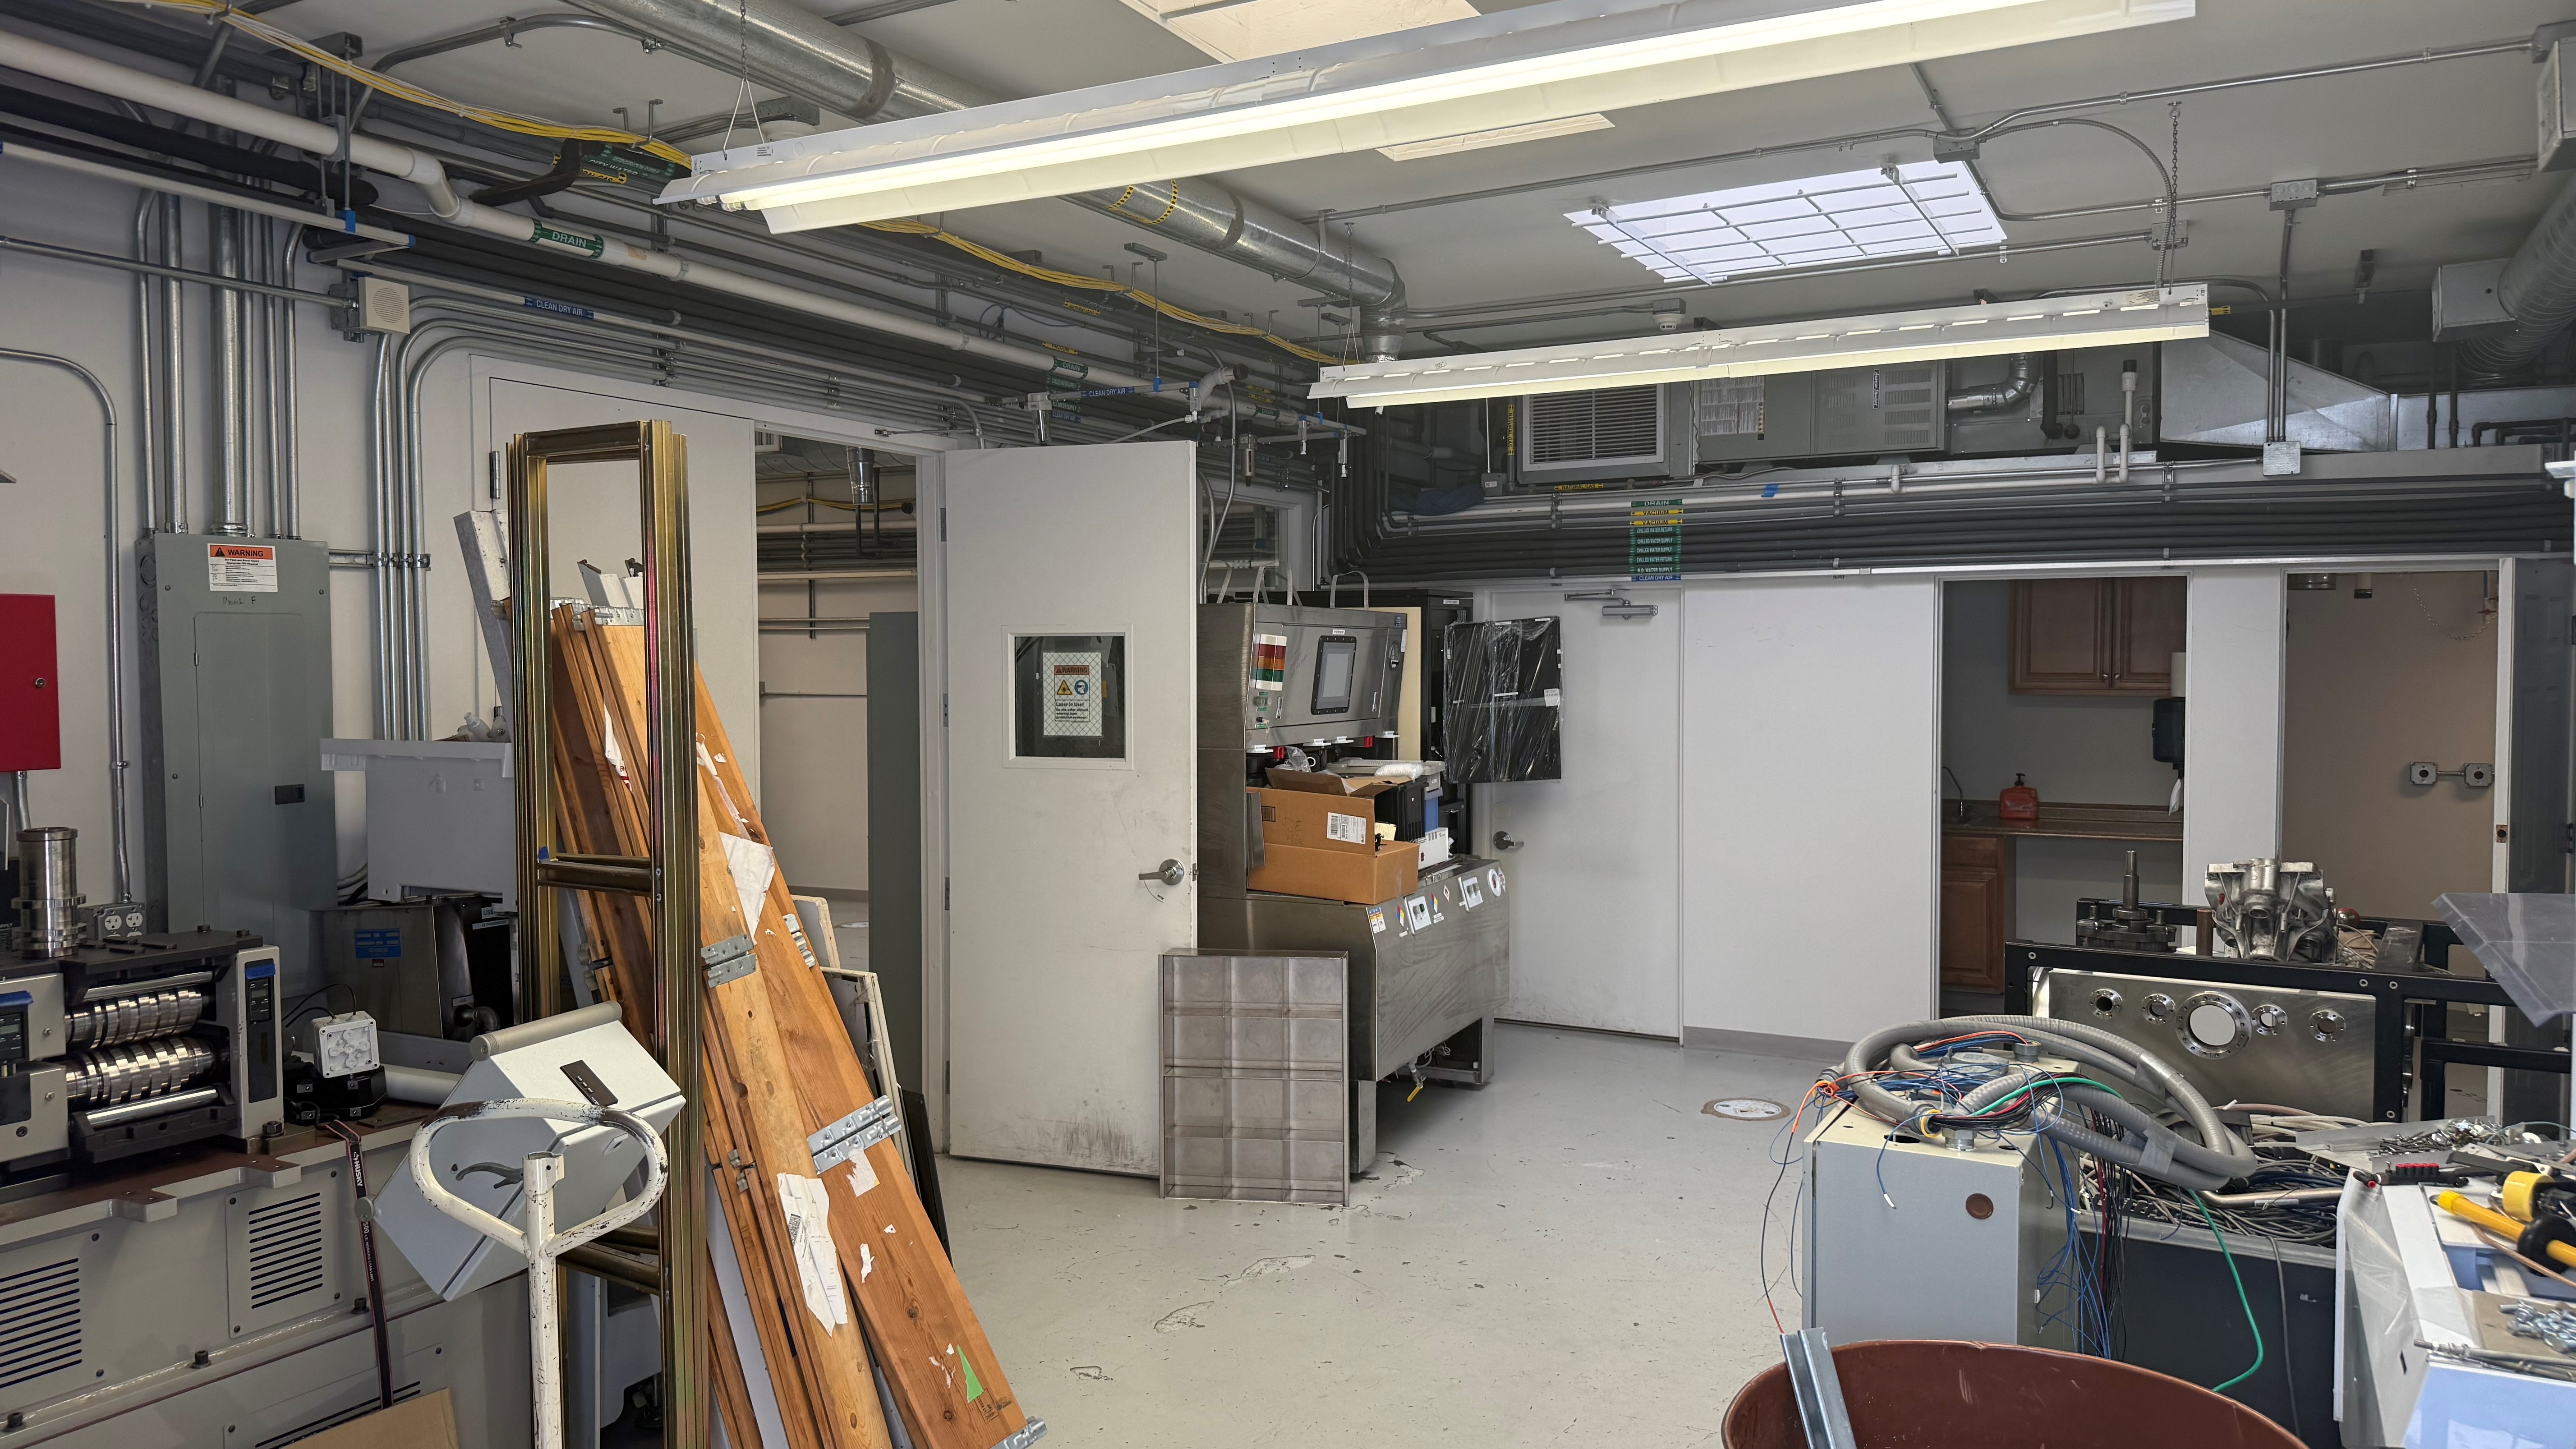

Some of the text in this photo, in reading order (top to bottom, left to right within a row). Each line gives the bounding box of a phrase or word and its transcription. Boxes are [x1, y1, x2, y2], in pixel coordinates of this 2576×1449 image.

[552, 231, 586, 248] DRAIN
[537, 300, 583, 316] CLEAN DRY AIR
[1063, 362, 1080, 371] DRAIN
[354, 1161, 363, 1187] HUSKY
